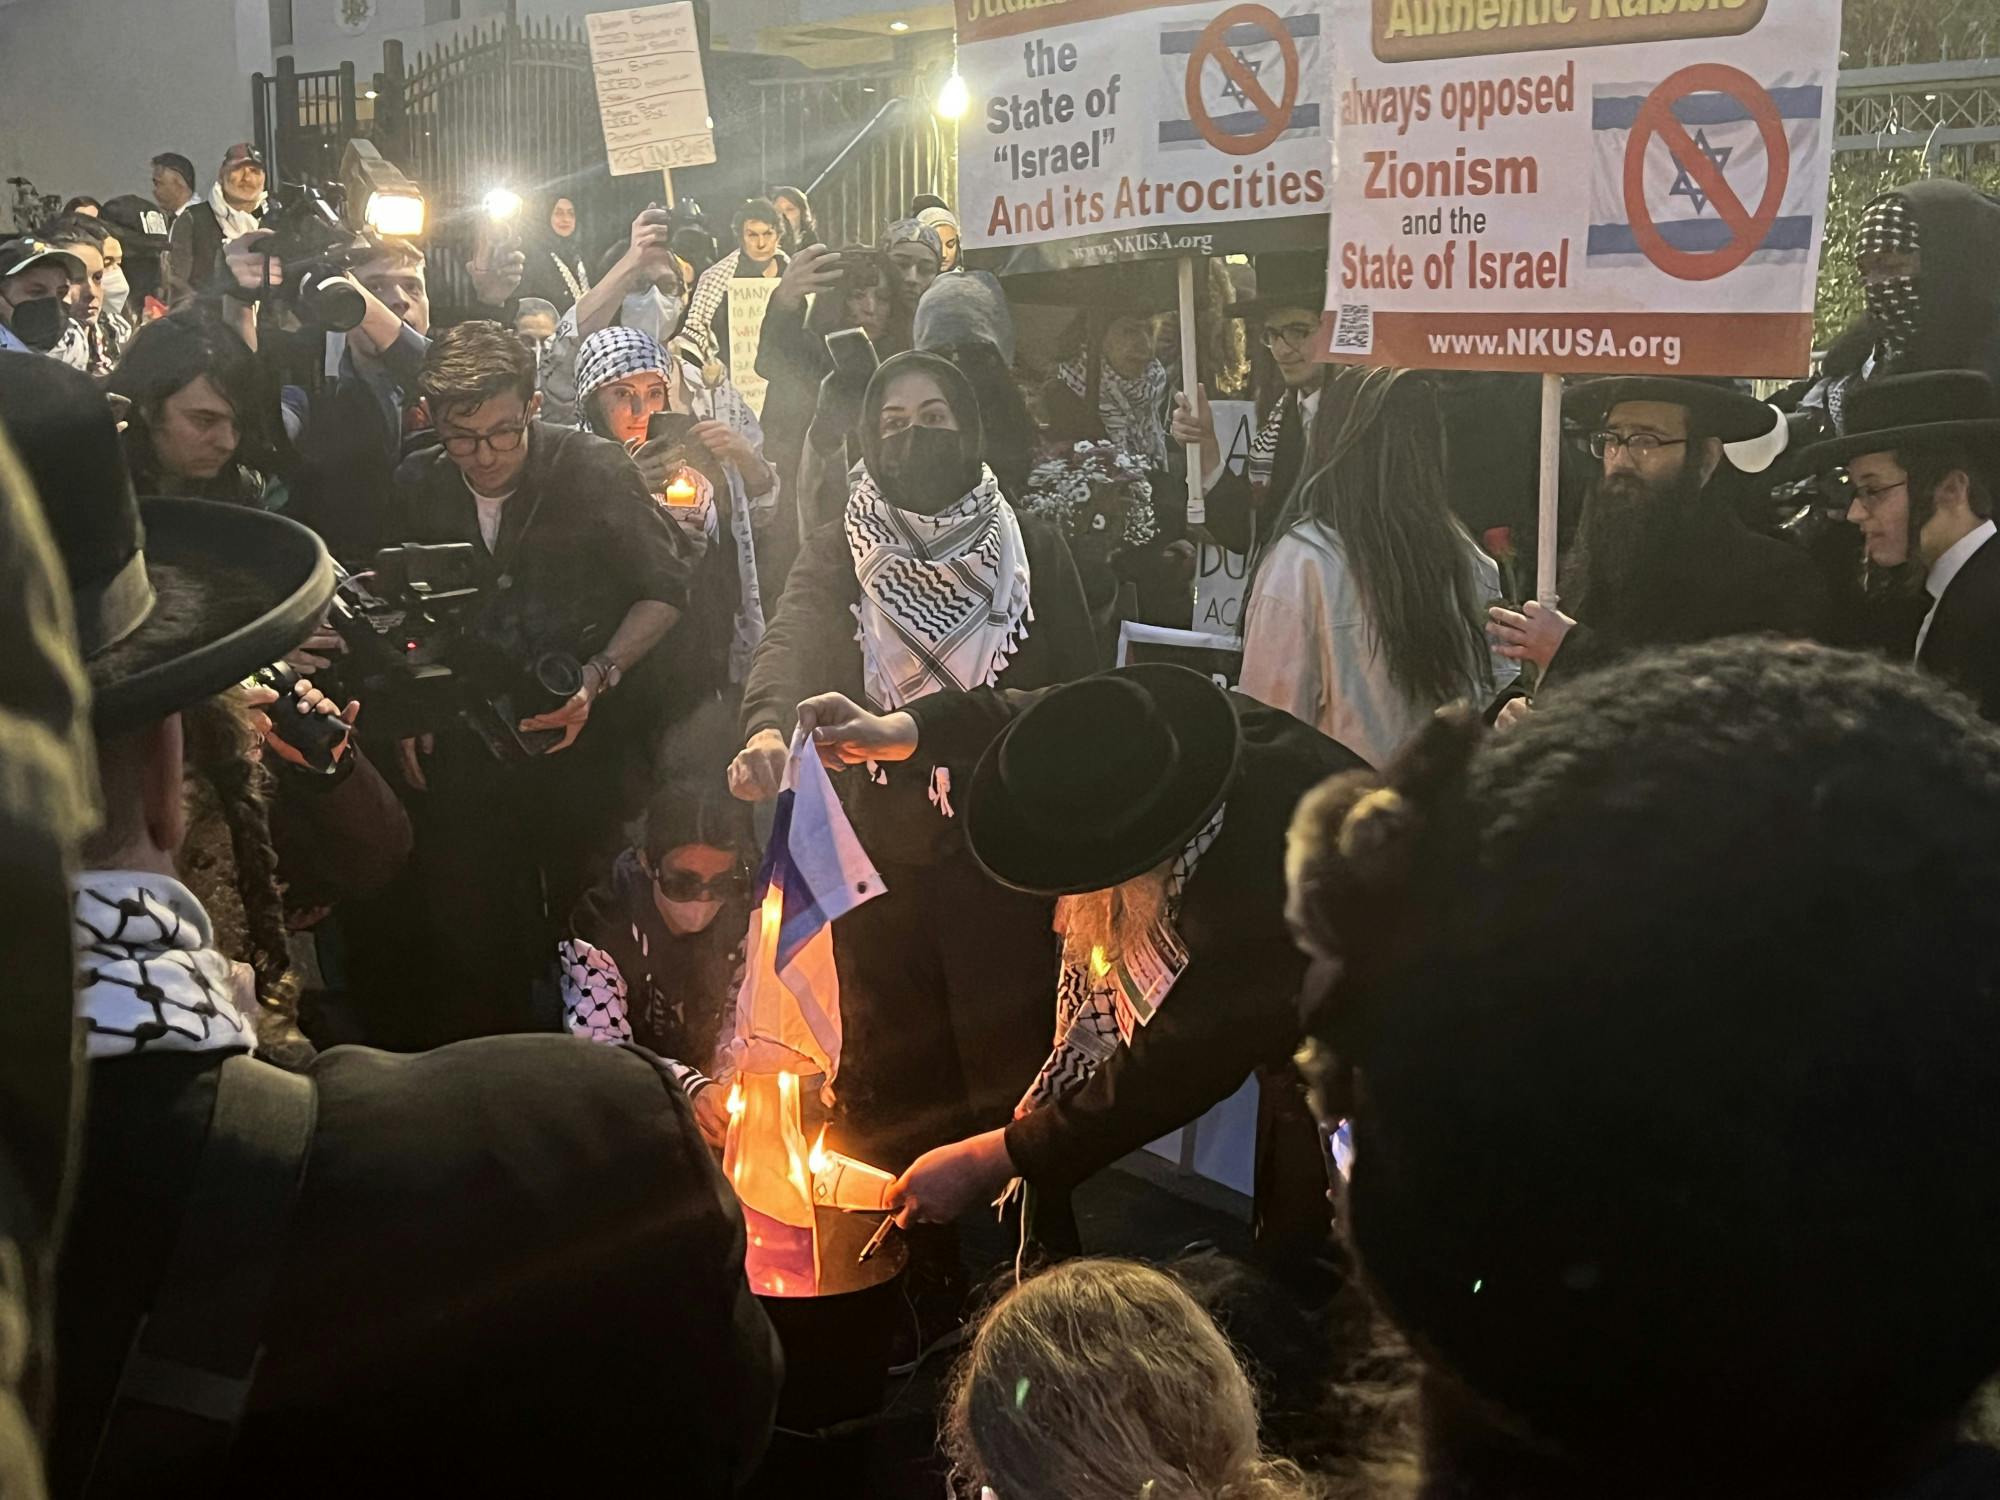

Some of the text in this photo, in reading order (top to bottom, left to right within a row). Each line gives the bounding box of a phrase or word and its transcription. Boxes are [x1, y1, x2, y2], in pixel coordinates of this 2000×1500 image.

[1023, 38, 1078, 78] the
[986, 74, 1121, 135] State of
[1341, 60, 1574, 136] always opposed
[1363, 148, 1538, 199] Zionism
[987, 163, 1325, 237] And its Atrocities
[1402, 207, 1486, 235] and the
[1341, 238, 1569, 290] State of Israel
[1428, 327, 1681, 365] www.NKUSA.org
[1203, 597, 1238, 627] AC
